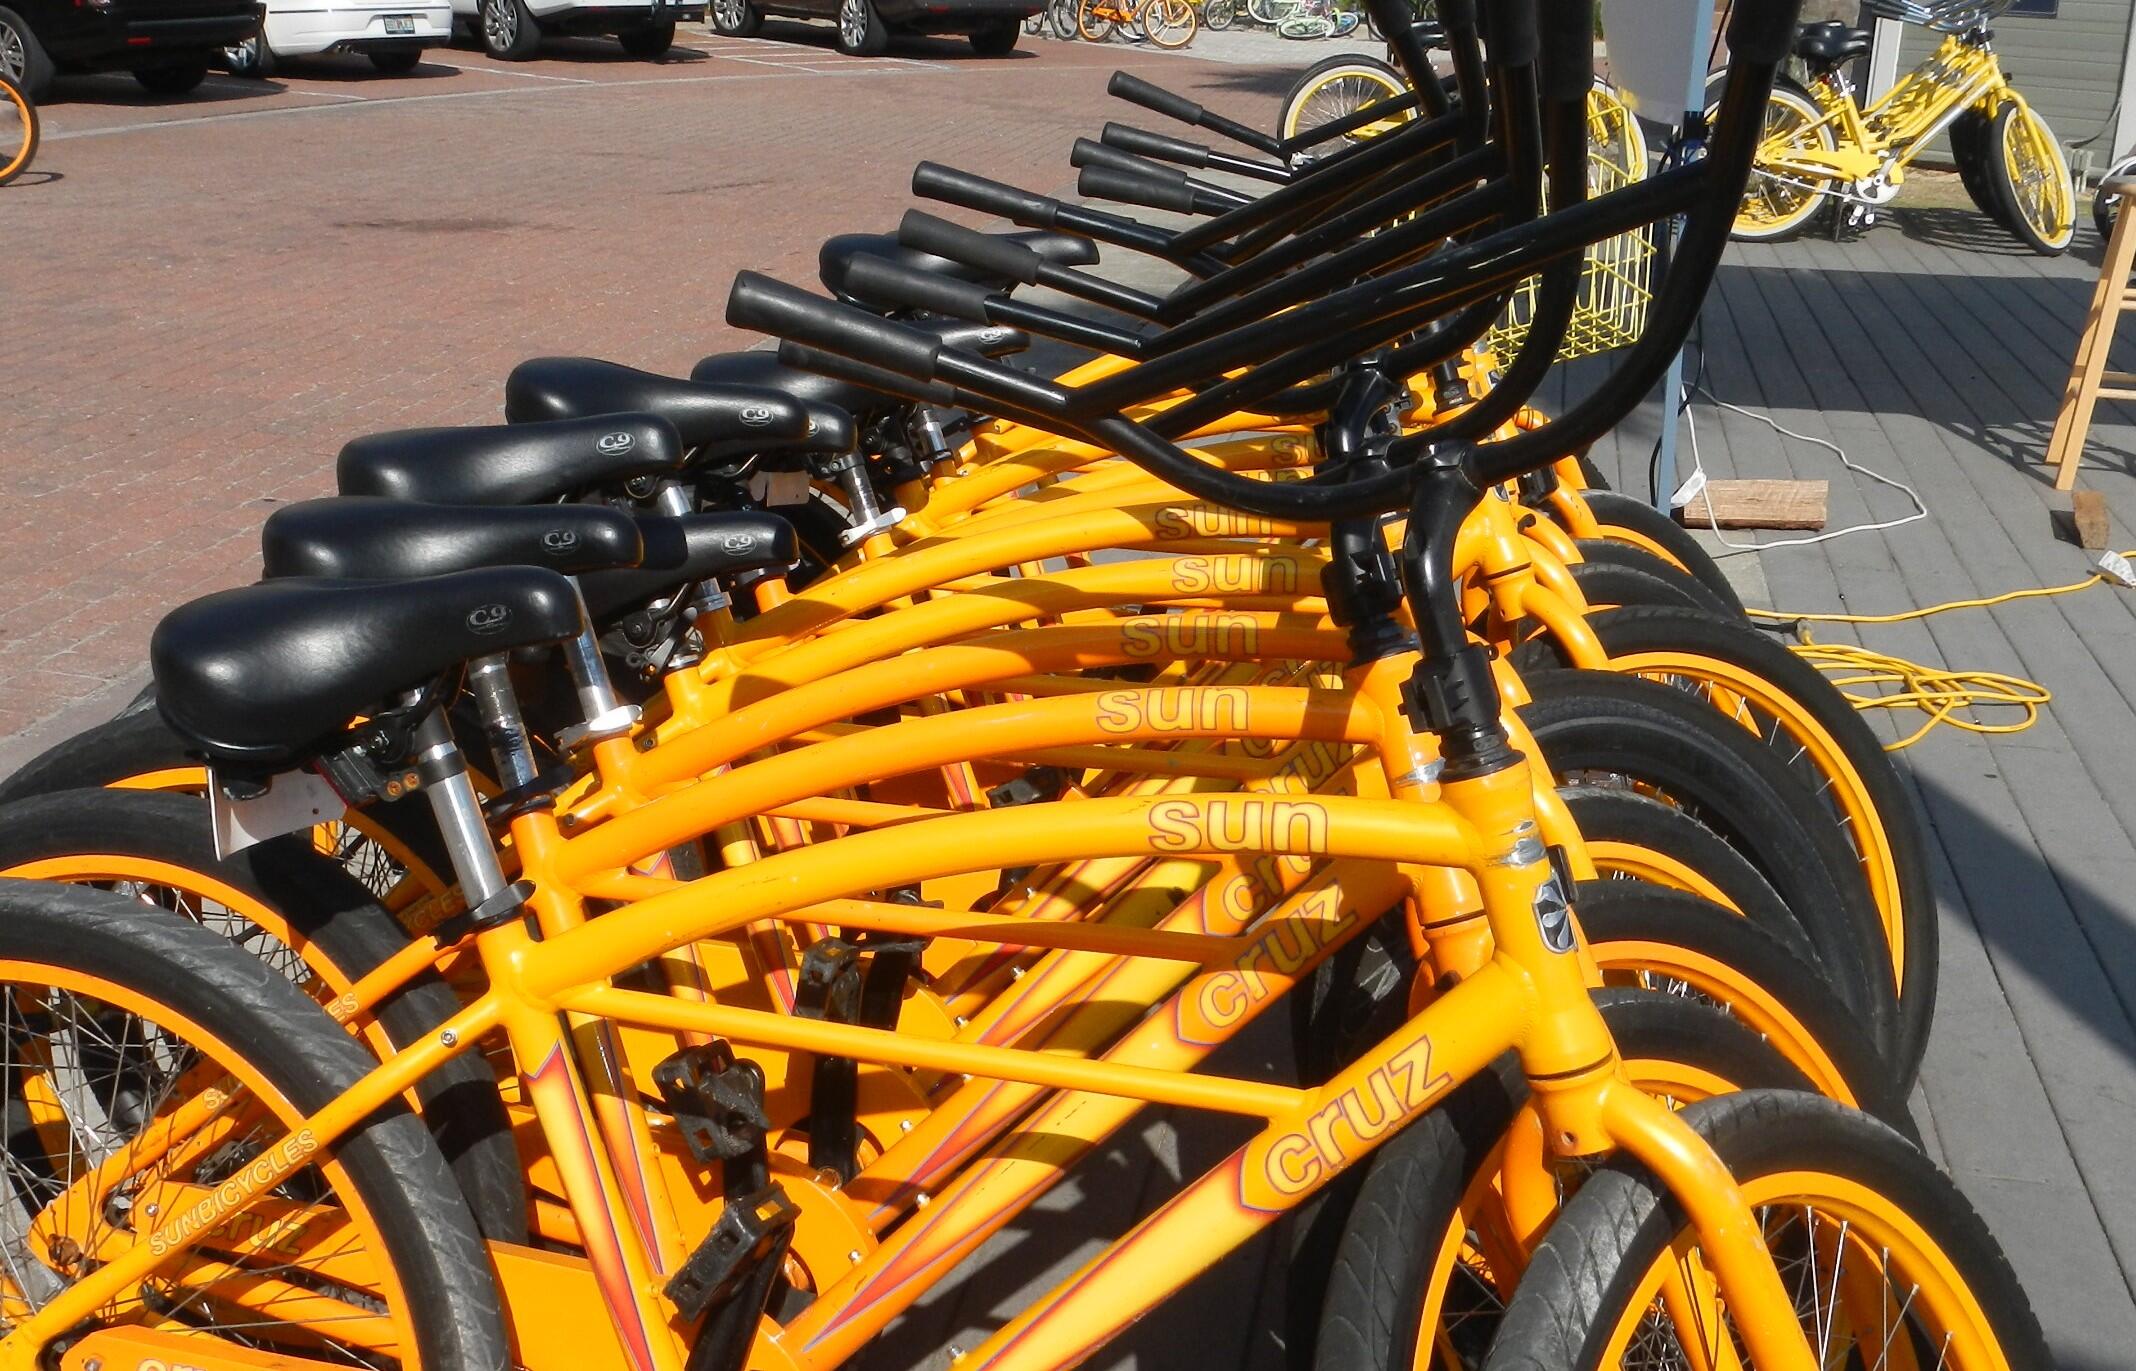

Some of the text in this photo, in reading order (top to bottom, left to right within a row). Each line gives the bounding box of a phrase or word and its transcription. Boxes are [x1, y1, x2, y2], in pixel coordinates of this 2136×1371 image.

[1171, 555, 1298, 594] sun
[1121, 613, 1260, 657] sun
[1096, 687, 1249, 733] sun
[1148, 799, 1329, 852] sun
[1199, 877, 1360, 1029] cruz
[1264, 1034, 1453, 1195] cruz
